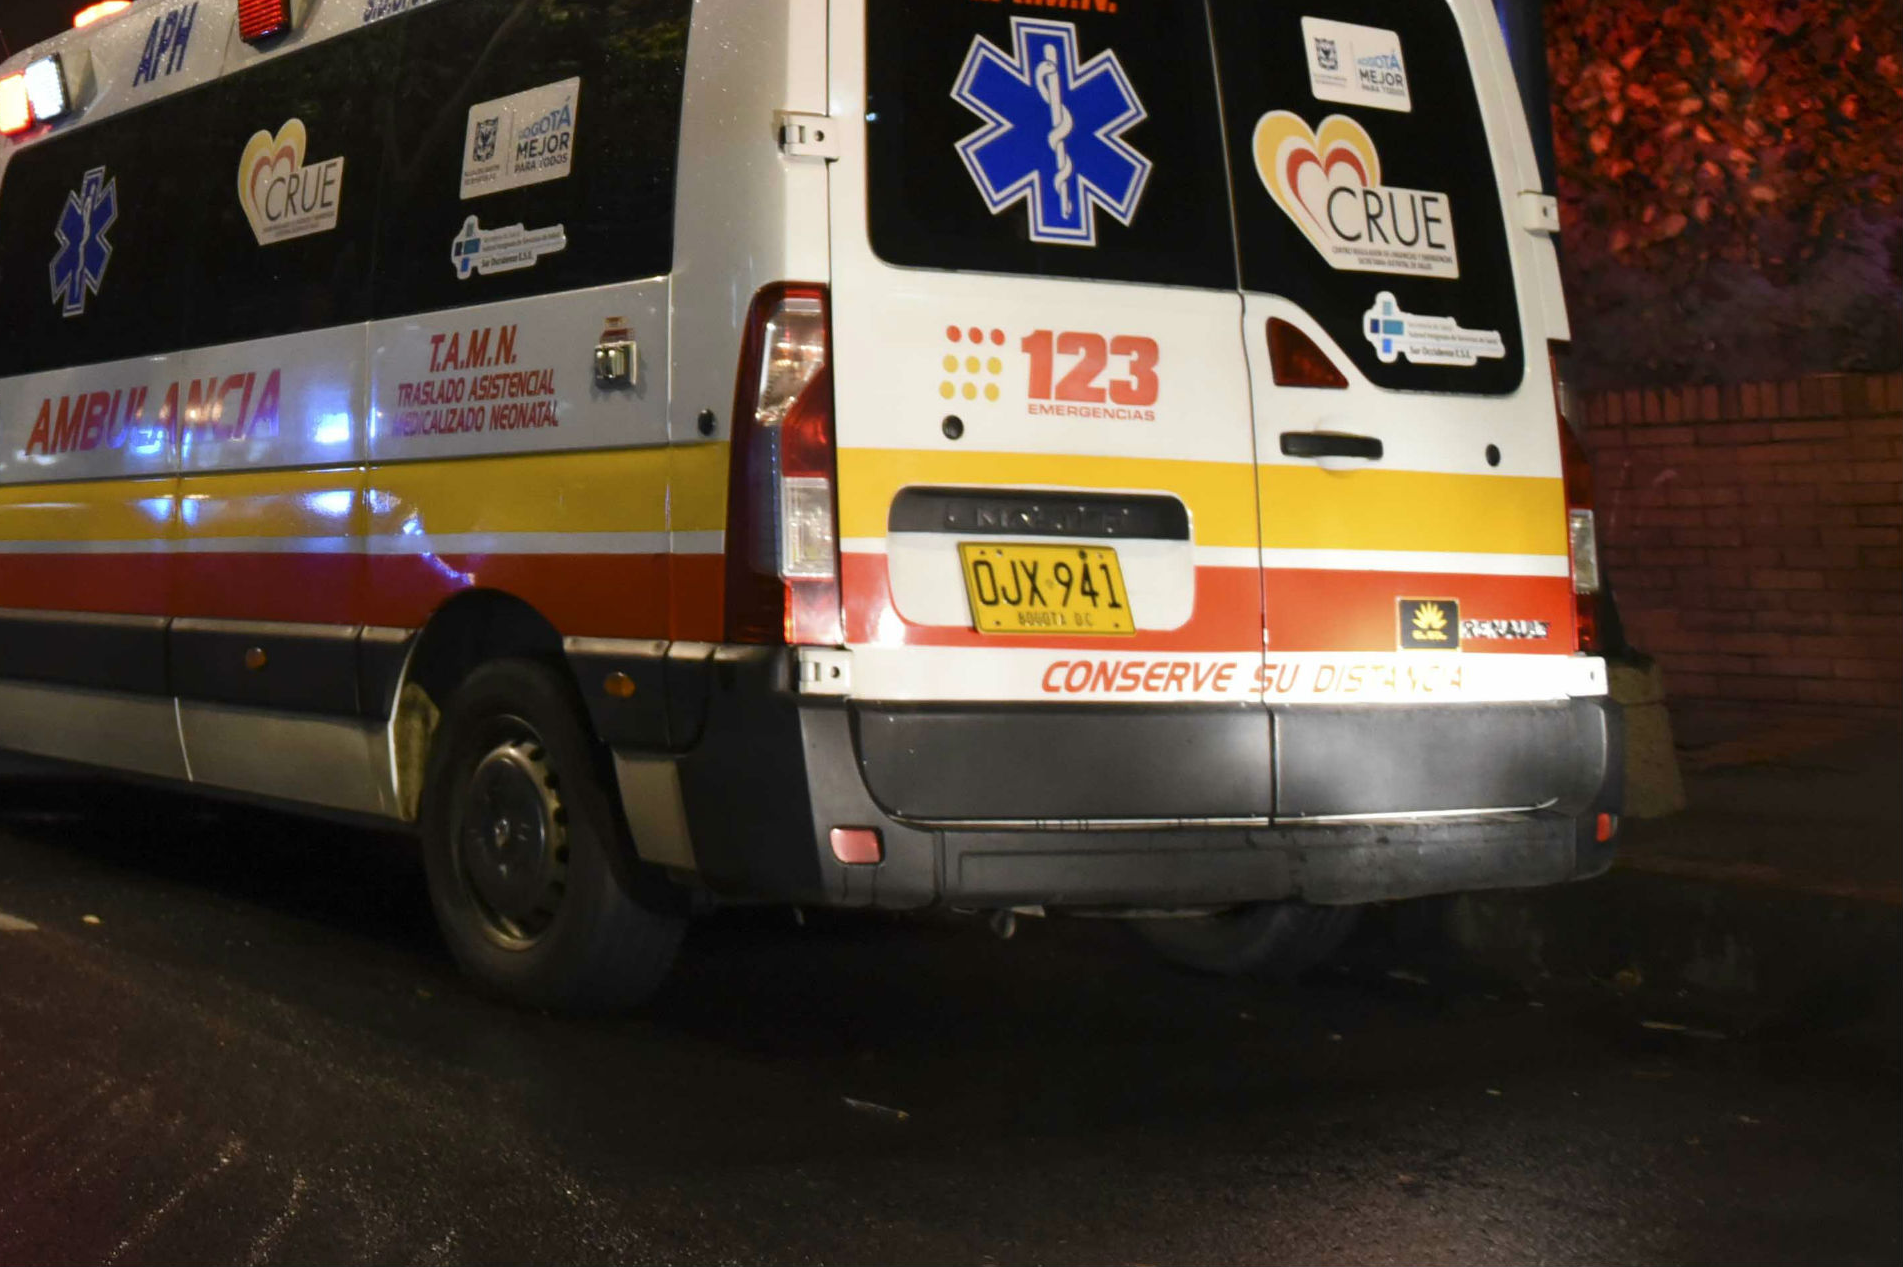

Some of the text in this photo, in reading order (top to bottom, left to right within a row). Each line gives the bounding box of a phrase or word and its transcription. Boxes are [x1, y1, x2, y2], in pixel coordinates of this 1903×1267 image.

[133, 1, 198, 88] APH
[1359, 68, 1404, 88] MEJOR
[518, 95, 572, 140] BOGOTÁ
[514, 153, 568, 173] PARA TODOS
[517, 132, 570, 161] MEJOR
[265, 161, 338, 222] CRUE
[1327, 185, 1447, 251] CRUE
[430, 324, 518, 373] T.A.M.N.
[1021, 329, 1160, 407] 123
[398, 368, 556, 408] TRASLADO ASISTENCIAL
[25, 368, 282, 457] AMBULANCIA
[488, 400, 559, 431] NEONATAL
[1026, 403, 1156, 422] EMERGENCIAS
[1054, 561, 1122, 609] 941
[1460, 620, 1550, 639] RENAULT
[1041, 660, 1463, 694] CONSERVE SU DISTANCA
